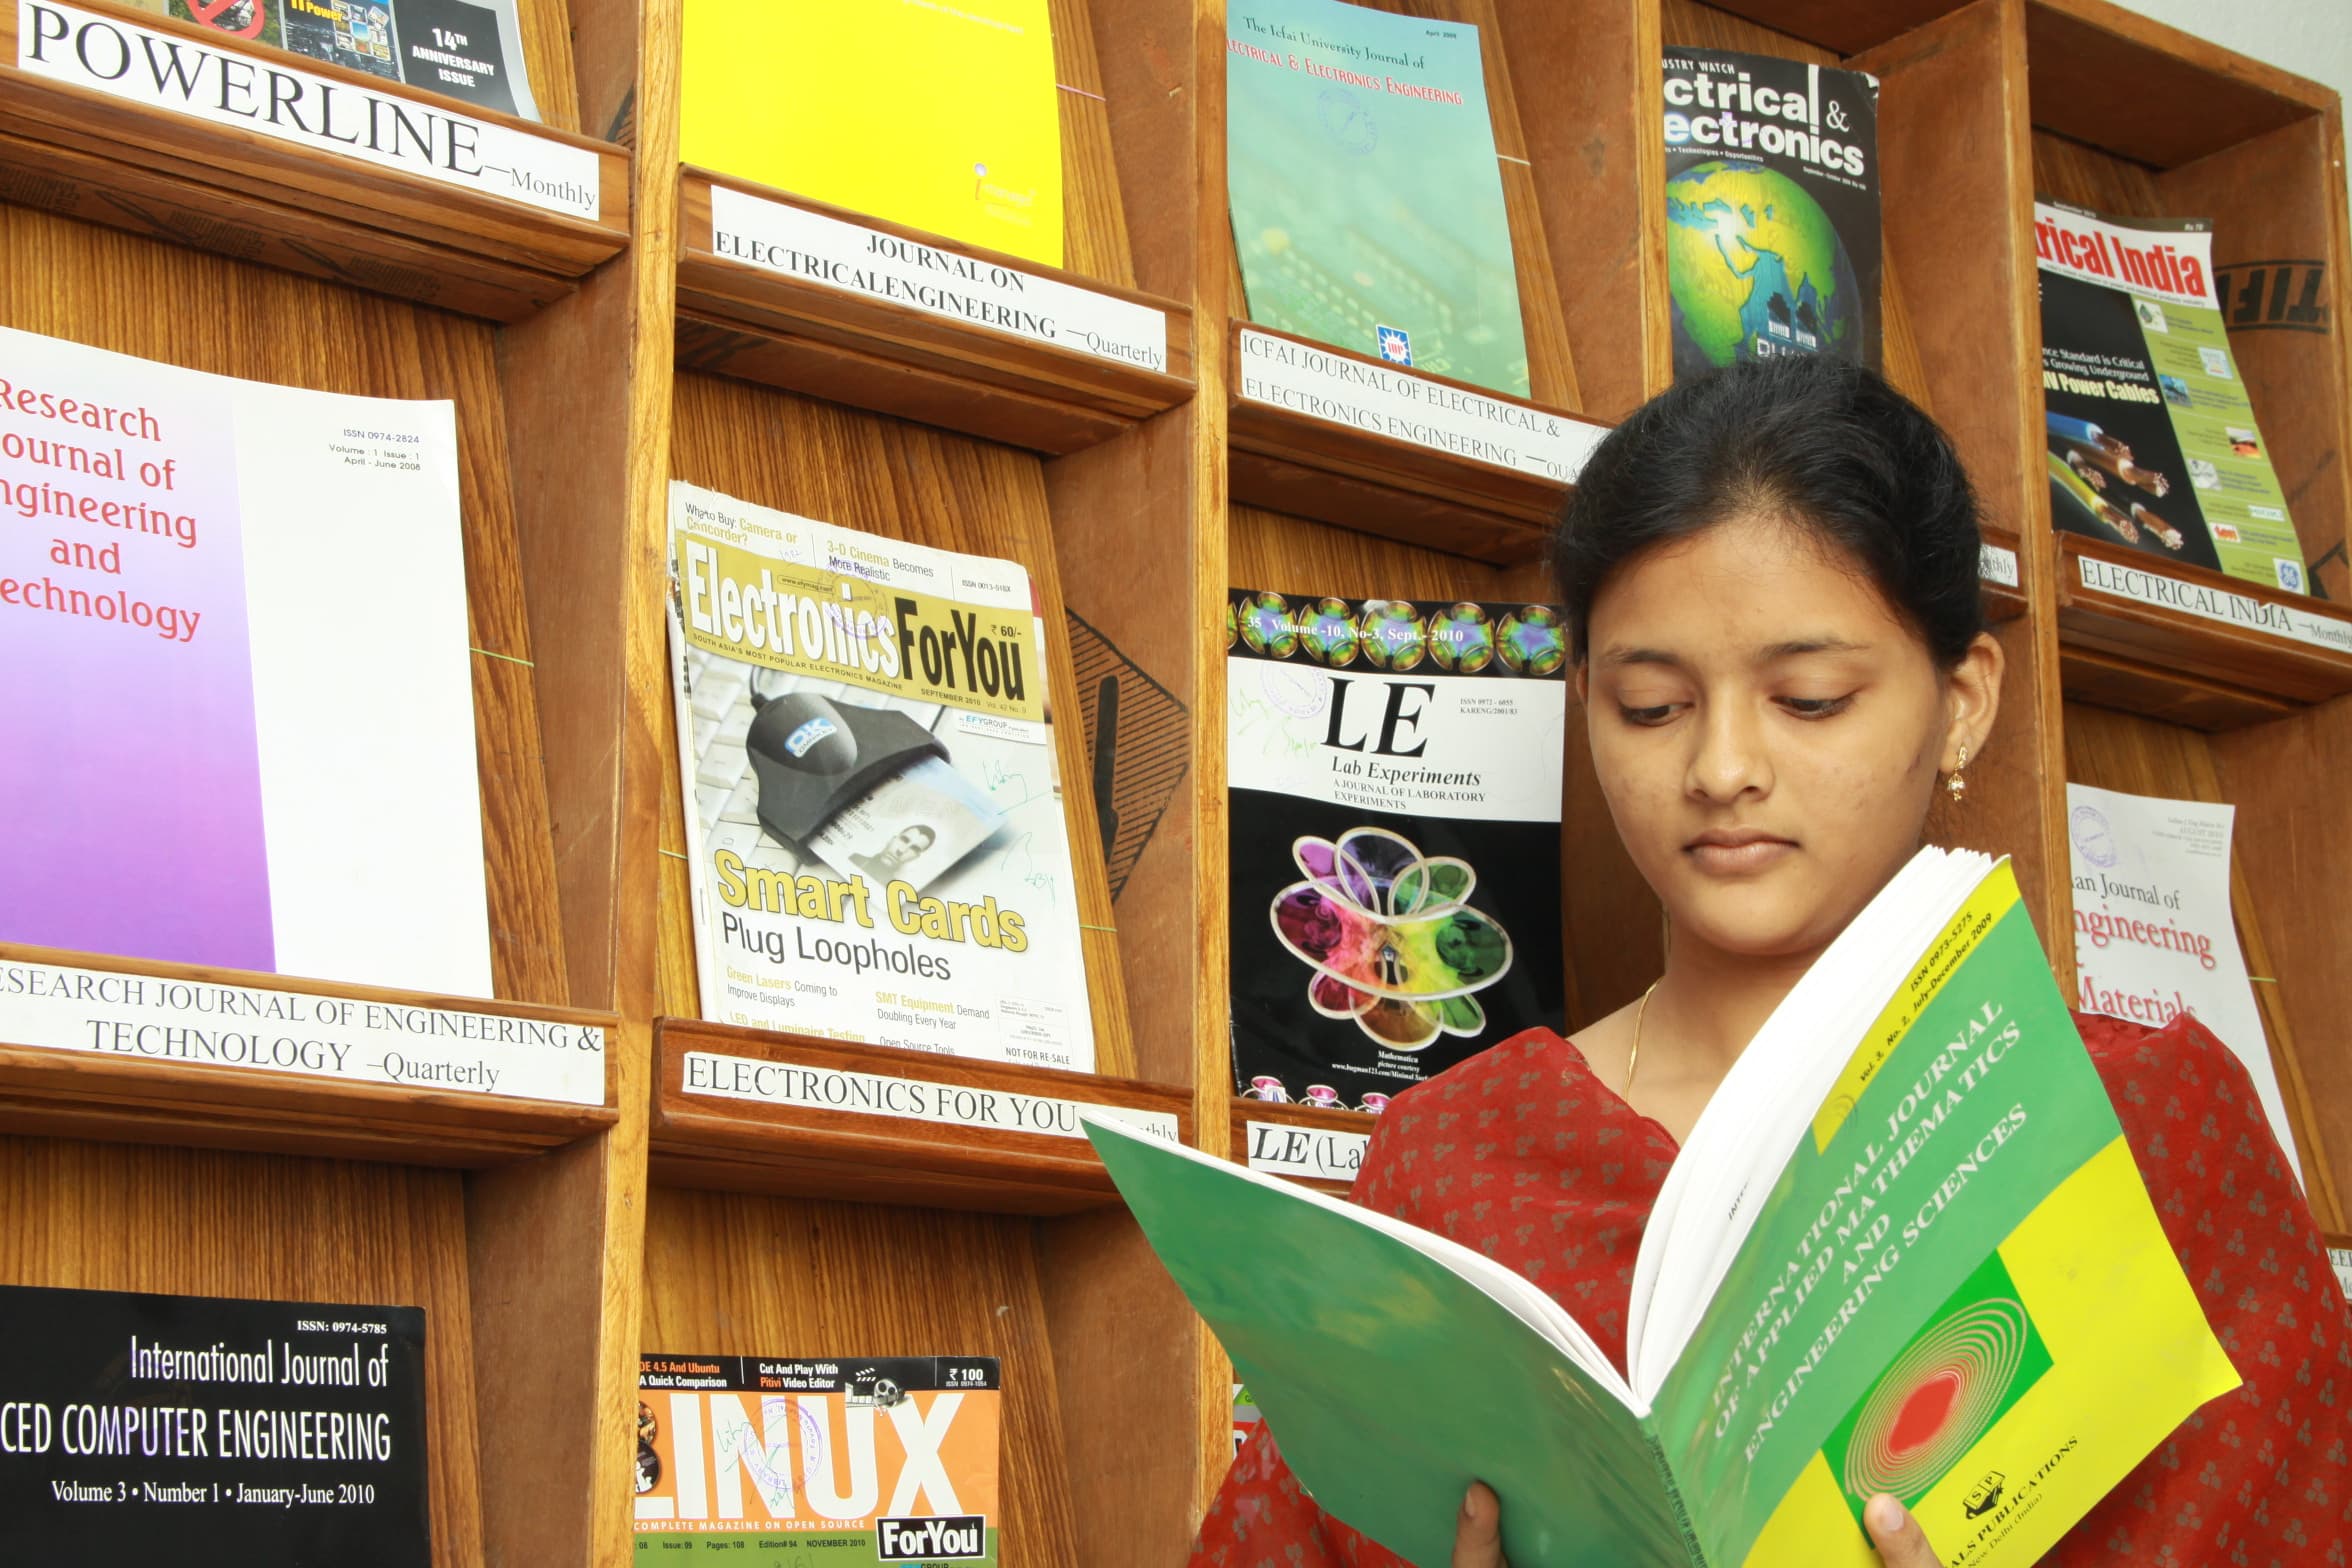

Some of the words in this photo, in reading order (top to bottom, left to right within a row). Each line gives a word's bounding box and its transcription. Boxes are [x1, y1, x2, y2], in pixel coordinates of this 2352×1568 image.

[431, 28, 468, 50] 14TH
[1243, 15, 1267, 34] The
[1270, 23, 1298, 42] Icfai
[1300, 31, 1361, 60] University
[1364, 47, 1409, 67] Journal
[1413, 55, 1425, 70] of
[411, 46, 495, 77] ANNIVERSARY
[438, 68, 476, 88] ISSUE
[1288, 53, 1300, 72] &
[1698, 61, 1736, 75] WATCH
[1663, 63, 1820, 127] ctrical
[1825, 99, 1850, 134] &
[1663, 110, 1865, 178] ectronics
[866, 233, 985, 284] JOURNAL
[990, 266, 1025, 294] ON
[2110, 236, 2207, 298] India
[2050, 358, 2090, 376] Growing
[2089, 365, 2150, 382] Underground
[2060, 348, 2101, 365] Standard
[2111, 356, 2145, 370] Critical
[1243, 334, 1296, 367] ICFAI
[1301, 350, 1392, 394] JOURNAL
[1396, 376, 1421, 401] OF
[1427, 386, 1542, 434] ELECTRICAL
[1546, 419, 1561, 439] &
[2060, 373, 2106, 399] Power
[2106, 379, 2160, 405] Cables
[0, 377, 162, 443] Research
[1245, 378, 1382, 432] ELECTRONICS
[1388, 416, 1517, 467] ENGINEERING
[329, 443, 366, 455] Volume
[383, 450, 407, 460] Issue
[343, 428, 365, 440] ISSN
[1, 432, 126, 482] ournal
[139, 458, 177, 491] of
[344, 456, 366, 466] April
[374, 459, 397, 469] June
[739, 517, 783, 541] Camera
[785, 531, 799, 545] or
[49, 538, 122, 575] and
[827, 539, 847, 556] 3-D
[849, 544, 890, 568] Cinema
[892, 557, 935, 578] Becomes
[828, 555, 853, 573] More
[853, 561, 891, 582] Realistic
[0, 576, 201, 643] echnology
[2081, 559, 2225, 617] ELECTRICAL
[2229, 594, 2293, 632] INDIA
[685, 537, 901, 682] Electronics
[894, 596, 1026, 702] ForYou
[1271, 619, 1319, 637] Volume
[1431, 629, 1465, 642] 2010
[692, 633, 717, 647] SOUTH
[718, 640, 744, 655] ASIA'S
[745, 649, 767, 662] MOST
[769, 655, 807, 670] POPULAR
[809, 663, 865, 682] ELECTRONICS
[865, 675, 903, 691] MAGAZINE
[920, 687, 964, 704] SEPTEMBER
[1320, 675, 1437, 758] LE
[1332, 755, 1362, 777] Lab
[1366, 761, 1483, 787] Experiments
[1334, 790, 1408, 810] EXPERIMENTS
[1342, 780, 1390, 797] JOURNAL
[1390, 786, 1406, 797] OF
[1407, 789, 1486, 803] LABORATORY
[712, 848, 875, 930] Smart
[885, 878, 1029, 954] Cards
[2099, 873, 2161, 908] Journal
[2163, 889, 2181, 911] of
[721, 911, 785, 965] Plug
[796, 925, 952, 982] Loopholes
[1929, 911, 1974, 968] 0973-5275
[2073, 903, 2217, 971] ngineering
[727, 965, 753, 983] Green
[756, 972, 792, 991] Lasers
[793, 980, 827, 998] Coming
[1912, 939, 1971, 1013] July-December
[727, 983, 758, 1002] Improve
[759, 991, 796, 1008] Displays
[875, 991, 898, 1006] SMT
[900, 994, 955, 1015] Equipment
[956, 1004, 991, 1020] Demand
[155, 983, 307, 1023] JOURNAL
[315, 1001, 355, 1027] OF
[365, 1004, 569, 1050] ENGINEERING
[576, 1025, 602, 1053] &
[877, 1008, 914, 1026] Doubling
[914, 1013, 938, 1029] Every
[938, 1017, 957, 1031] Year
[85, 1018, 353, 1073] TECHNOLOGY
[1005, 1046, 1021, 1058] NOT
[1022, 1048, 1039, 1060] FOR
[1039, 1051, 1071, 1065] RE-SALE
[687, 1056, 926, 1114] ELECTRONICS
[935, 1087, 999, 1124] FOR
[1010, 1097, 1079, 1134] YOU
[1712, 1140, 1885, 1408] INTERNATIONAL
[1887, 999, 2004, 1142] JOURNAL
[1841, 1212, 1892, 1286] AND
[1743, 1243, 1901, 1464] ENGINEERING
[1901, 1102, 2028, 1250] SCIENCES
[296, 1319, 330, 1334] ISSN:
[332, 1320, 388, 1336] 0974-5785
[1745, 1245, 1835, 1391] APPLIED
[130, 1334, 275, 1385] International
[280, 1339, 361, 1388] Journal
[367, 1342, 390, 1388] of
[653, 1361, 668, 1373] 4.5
[669, 1361, 688, 1373] And
[688, 1362, 721, 1375] Ubuntu
[759, 1362, 775, 1375] Cut
[775, 1363, 792, 1376] And
[793, 1364, 815, 1379] Play
[815, 1364, 839, 1377] With
[961, 1368, 984, 1381] 100
[649, 1375, 674, 1387] Quick
[675, 1375, 728, 1390] Comparison
[759, 1376, 783, 1389] Pitivi
[783, 1376, 803, 1389] Video
[803, 1377, 836, 1389] Editor
[0, 1401, 52, 1454] CED
[62, 1403, 210, 1459] COMPUTER
[218, 1408, 392, 1462] ENGINEERING
[51, 1479, 113, 1502] Volume
[143, 1481, 208, 1504] Number
[236, 1483, 335, 1509] January-June
[338, 1484, 376, 1506] 2010
[1977, 1434, 2079, 1542] PUBLICATIONS
[633, 1520, 695, 1532] COMPLETE
[699, 1519, 761, 1531] MAGAZINE
[765, 1519, 782, 1530] ON
[785, 1519, 816, 1530] OPEN
[820, 1518, 866, 1530] SOURCE
[882, 1520, 978, 1556] ForYou
[806, 1539, 848, 1548] NOVEMBER
